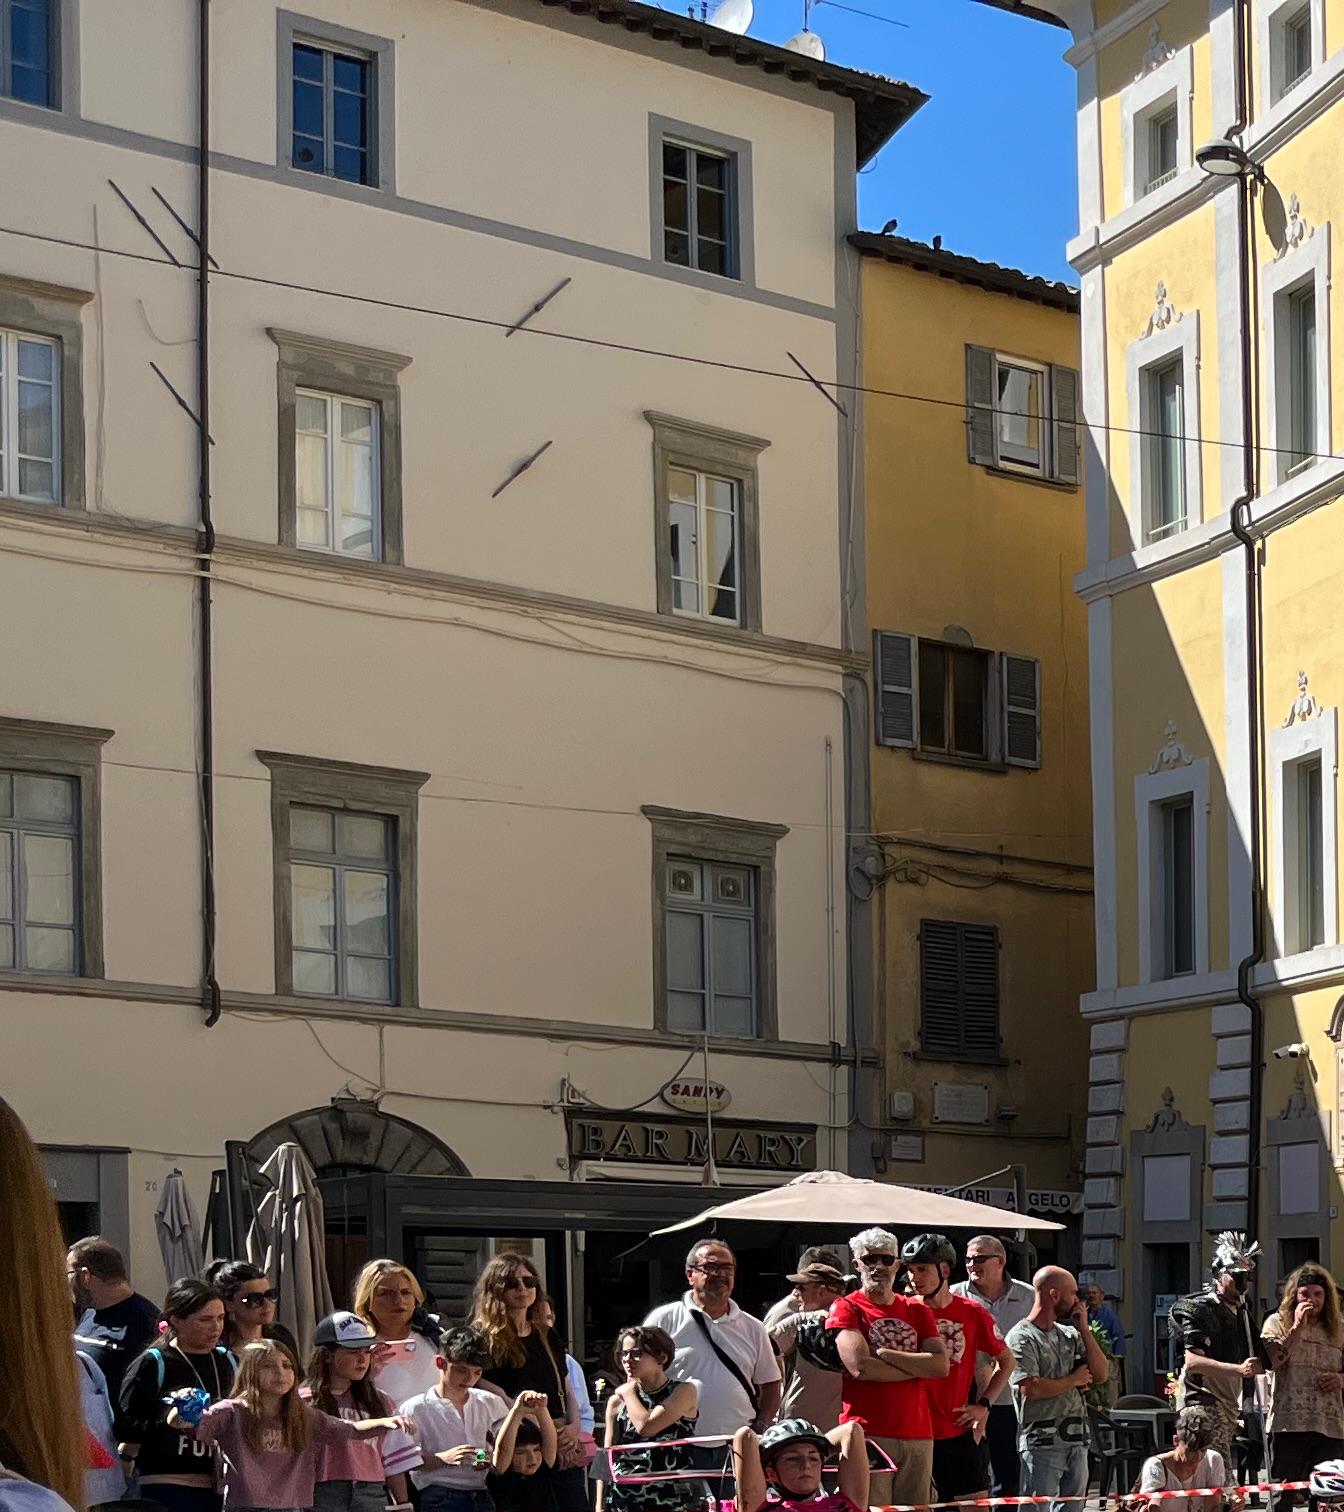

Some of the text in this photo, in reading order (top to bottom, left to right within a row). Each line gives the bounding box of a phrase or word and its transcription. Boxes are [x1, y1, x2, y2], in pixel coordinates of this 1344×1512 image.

[578, 1123, 811, 1167] BAR MARY
[1007, 1192, 1071, 1208] AGELO
[178, 1435, 213, 1458] FU
